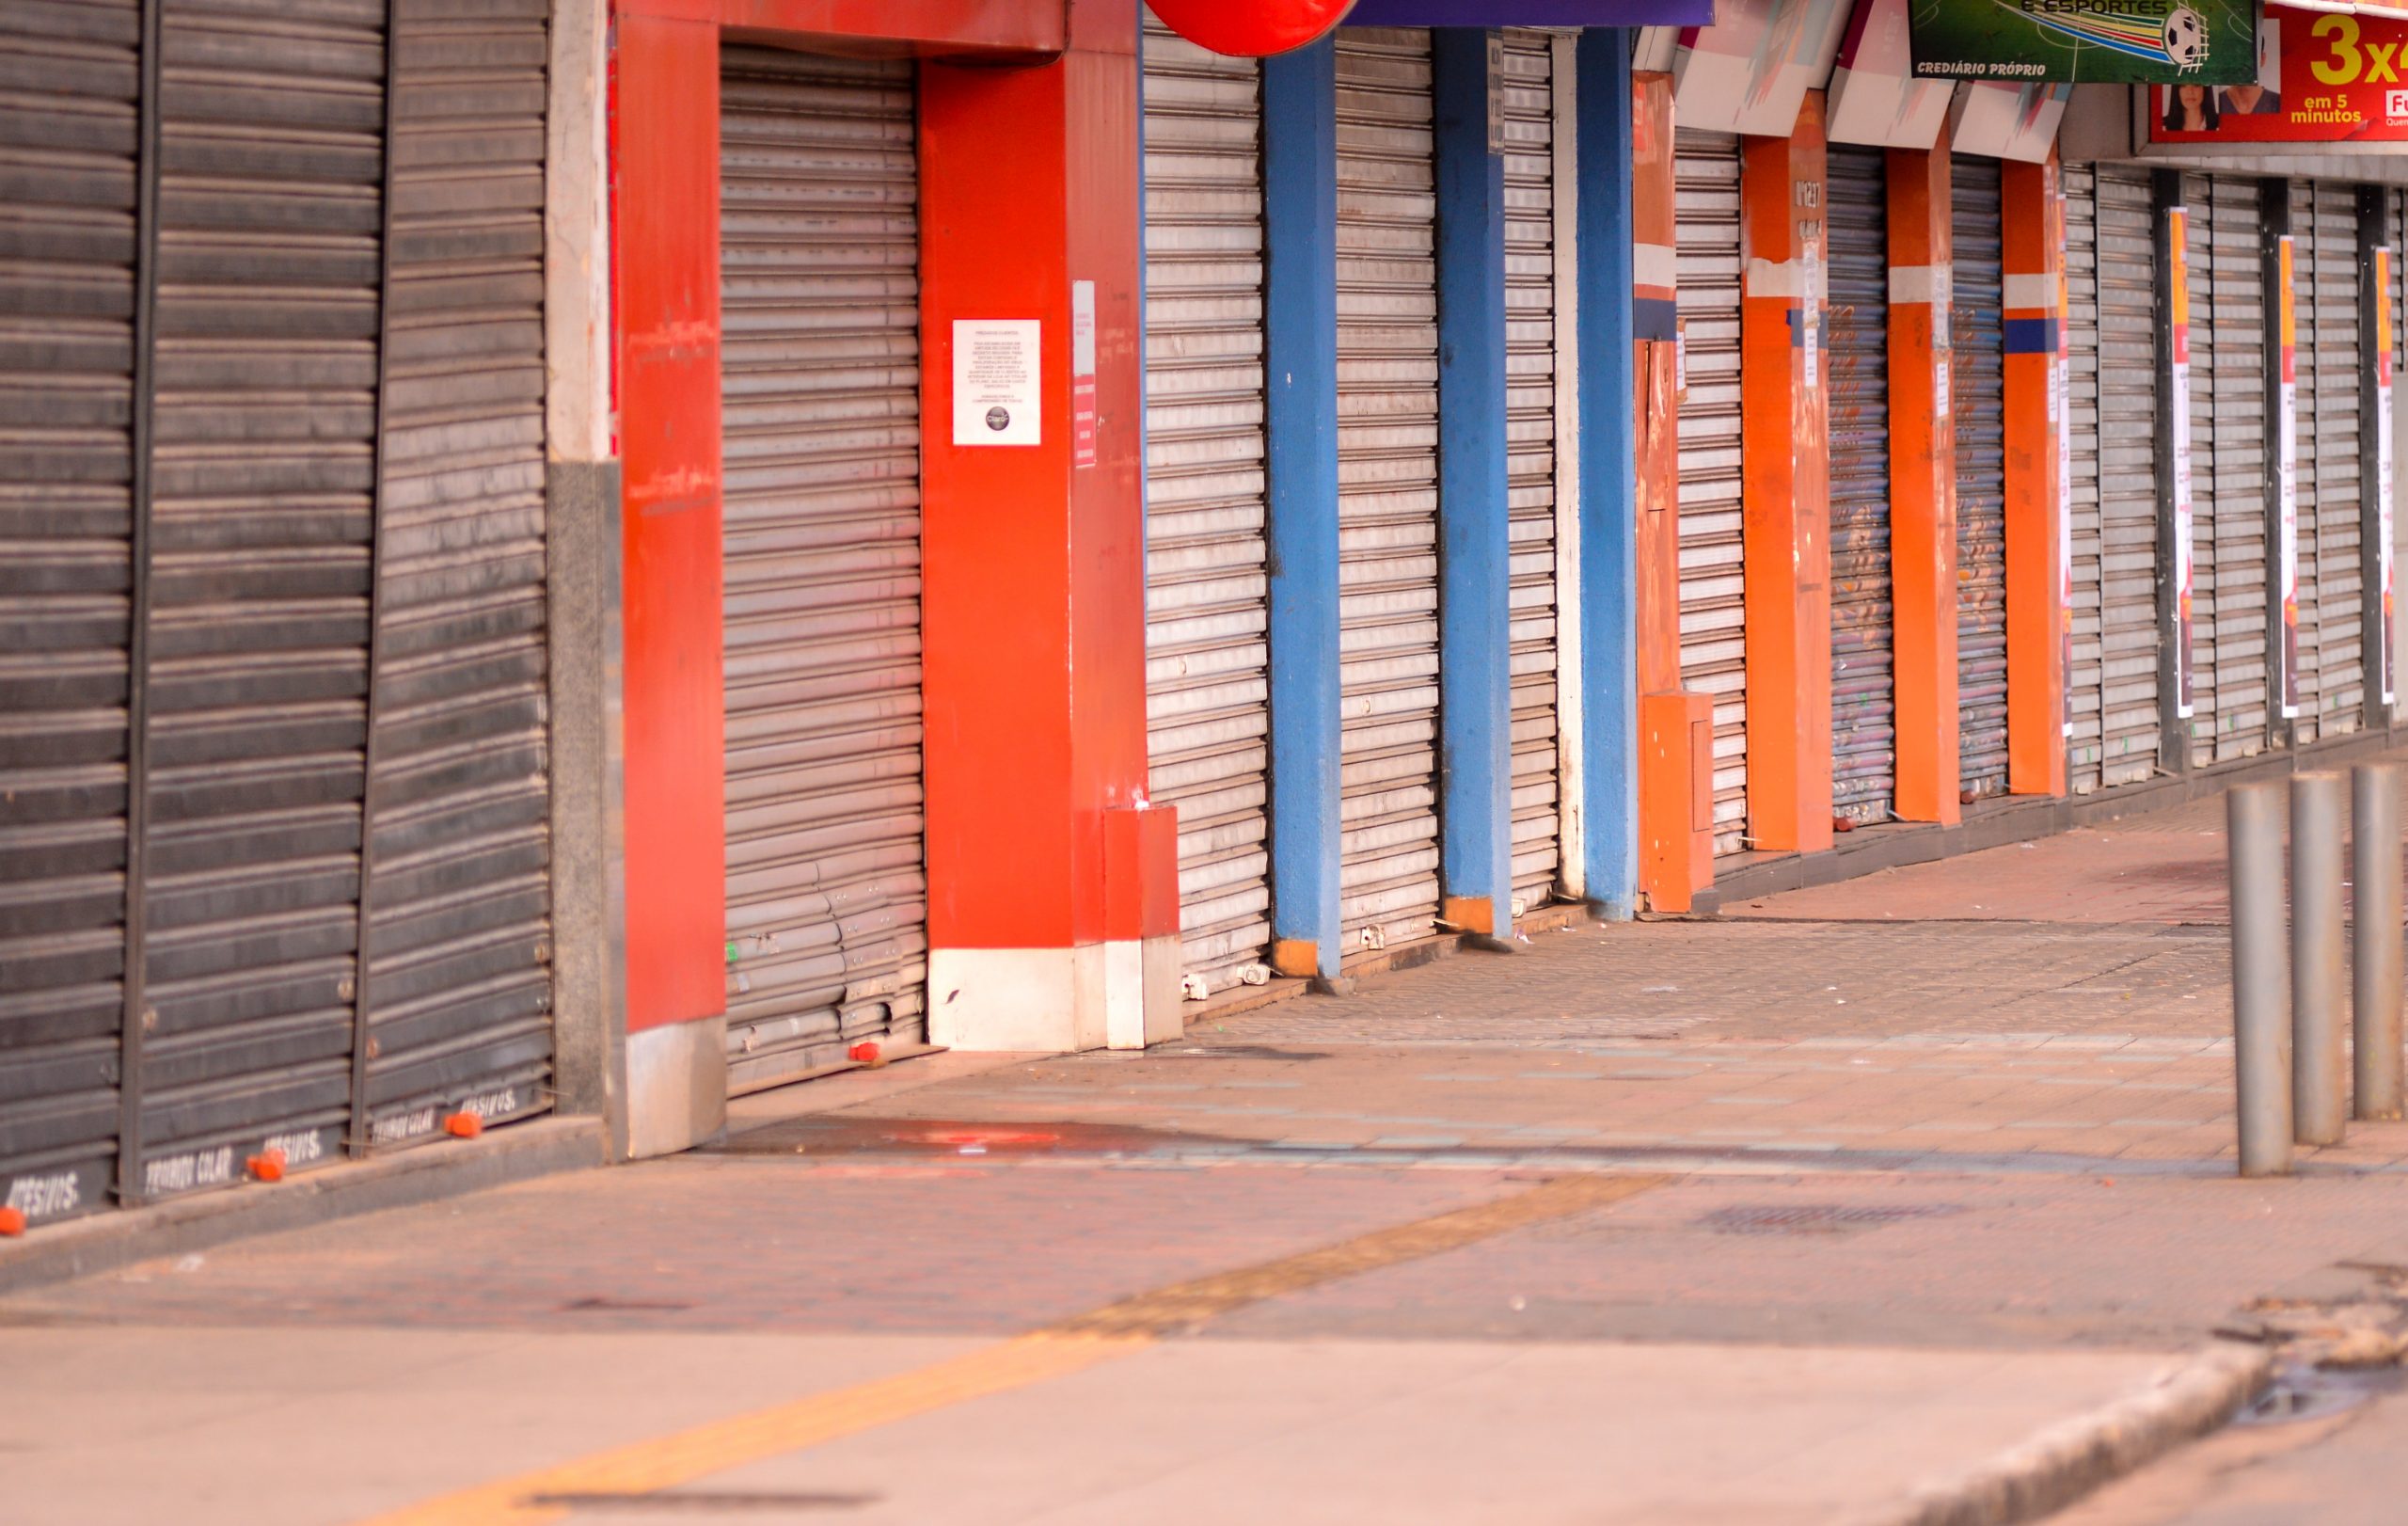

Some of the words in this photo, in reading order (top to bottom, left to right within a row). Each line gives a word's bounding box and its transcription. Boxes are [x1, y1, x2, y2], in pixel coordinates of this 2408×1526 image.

[2044, 0, 2167, 14] ESPORTES
[2310, 13, 2408, 86] 3x
[1917, 60, 1986, 74] CREDIÁRIO
[1988, 61, 2046, 76] PRÓPRIO
[2305, 97, 2331, 108] em
[2337, 94, 2348, 108] 5
[2291, 109, 2362, 123] minutos
